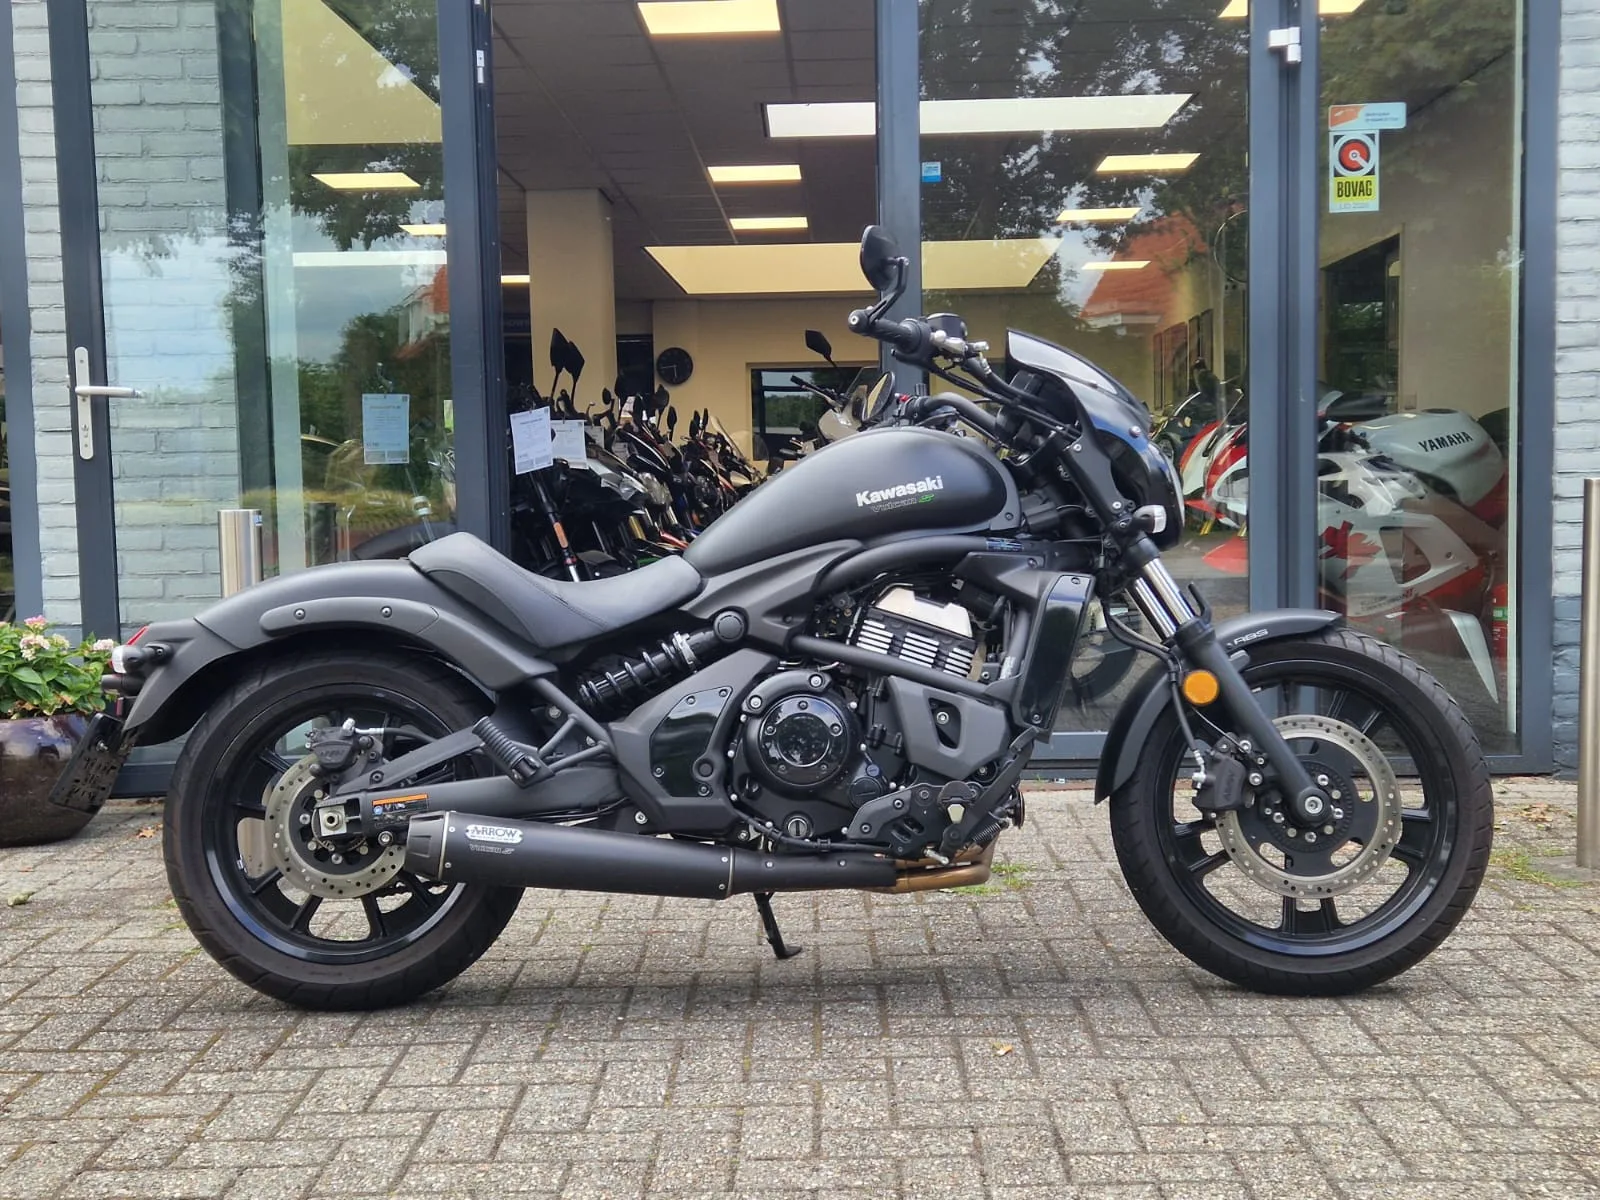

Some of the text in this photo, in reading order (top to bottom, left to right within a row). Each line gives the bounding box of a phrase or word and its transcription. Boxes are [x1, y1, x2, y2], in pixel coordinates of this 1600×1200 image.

[1337, 180, 1373, 198] BOVAG
[1418, 432, 1474, 452] YAMAHA
[856, 475, 943, 507] Kawasaki
[1233, 628, 1269, 645] ABS
[470, 826, 517, 838] ARROW
